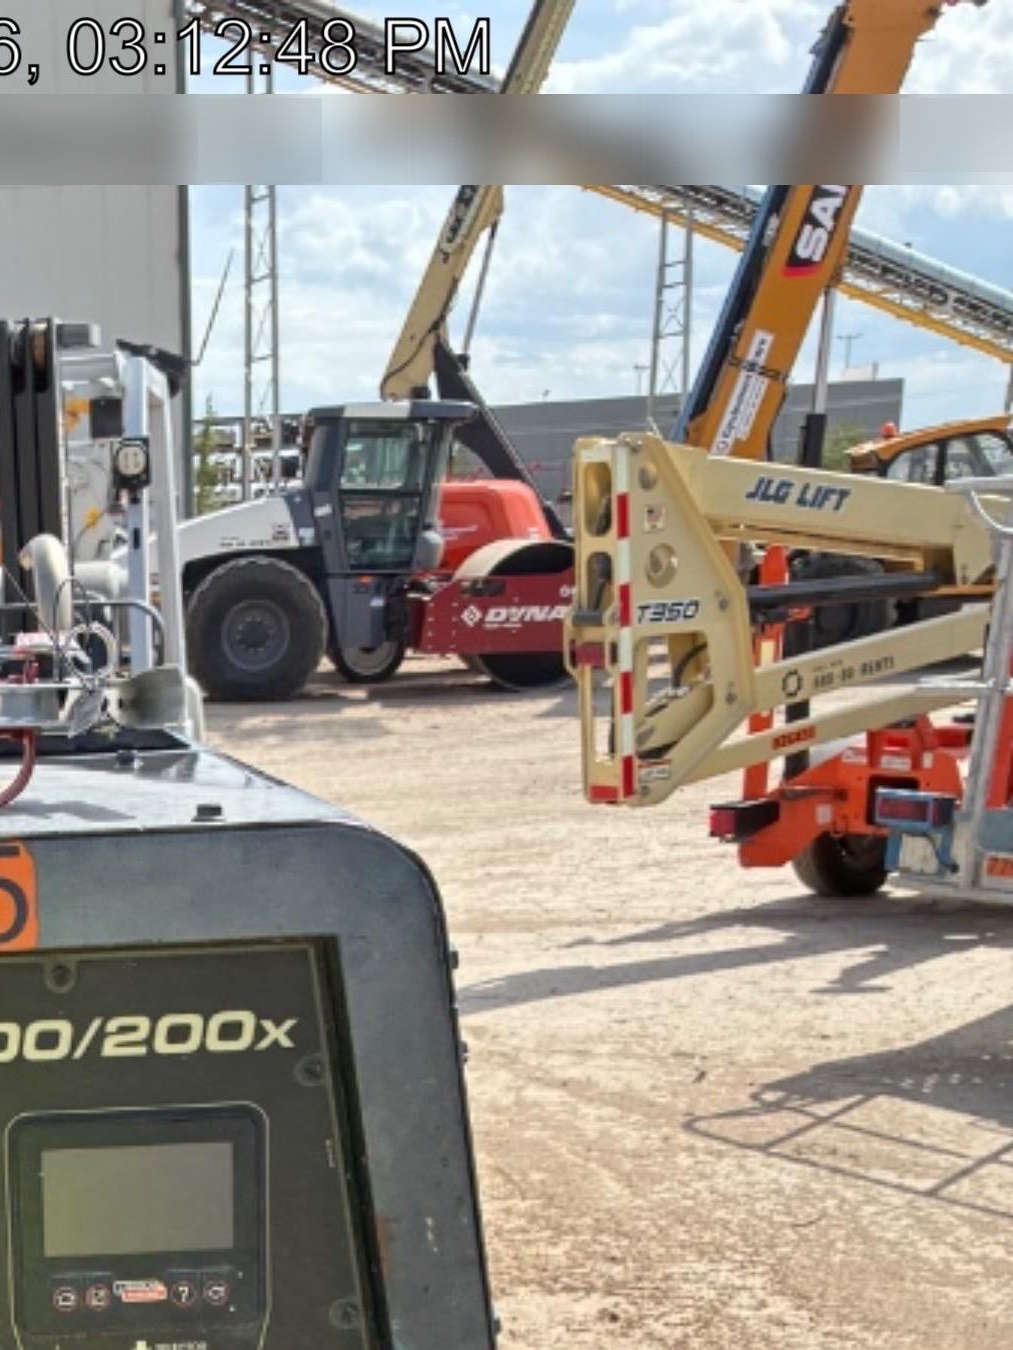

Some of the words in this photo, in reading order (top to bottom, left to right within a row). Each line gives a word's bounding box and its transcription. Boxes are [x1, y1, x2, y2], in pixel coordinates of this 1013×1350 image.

[745, 476, 794, 505] JLG
[796, 481, 851, 511] LIFT
[484, 605, 572, 623] DYNA
[637, 600, 700, 624] T350
